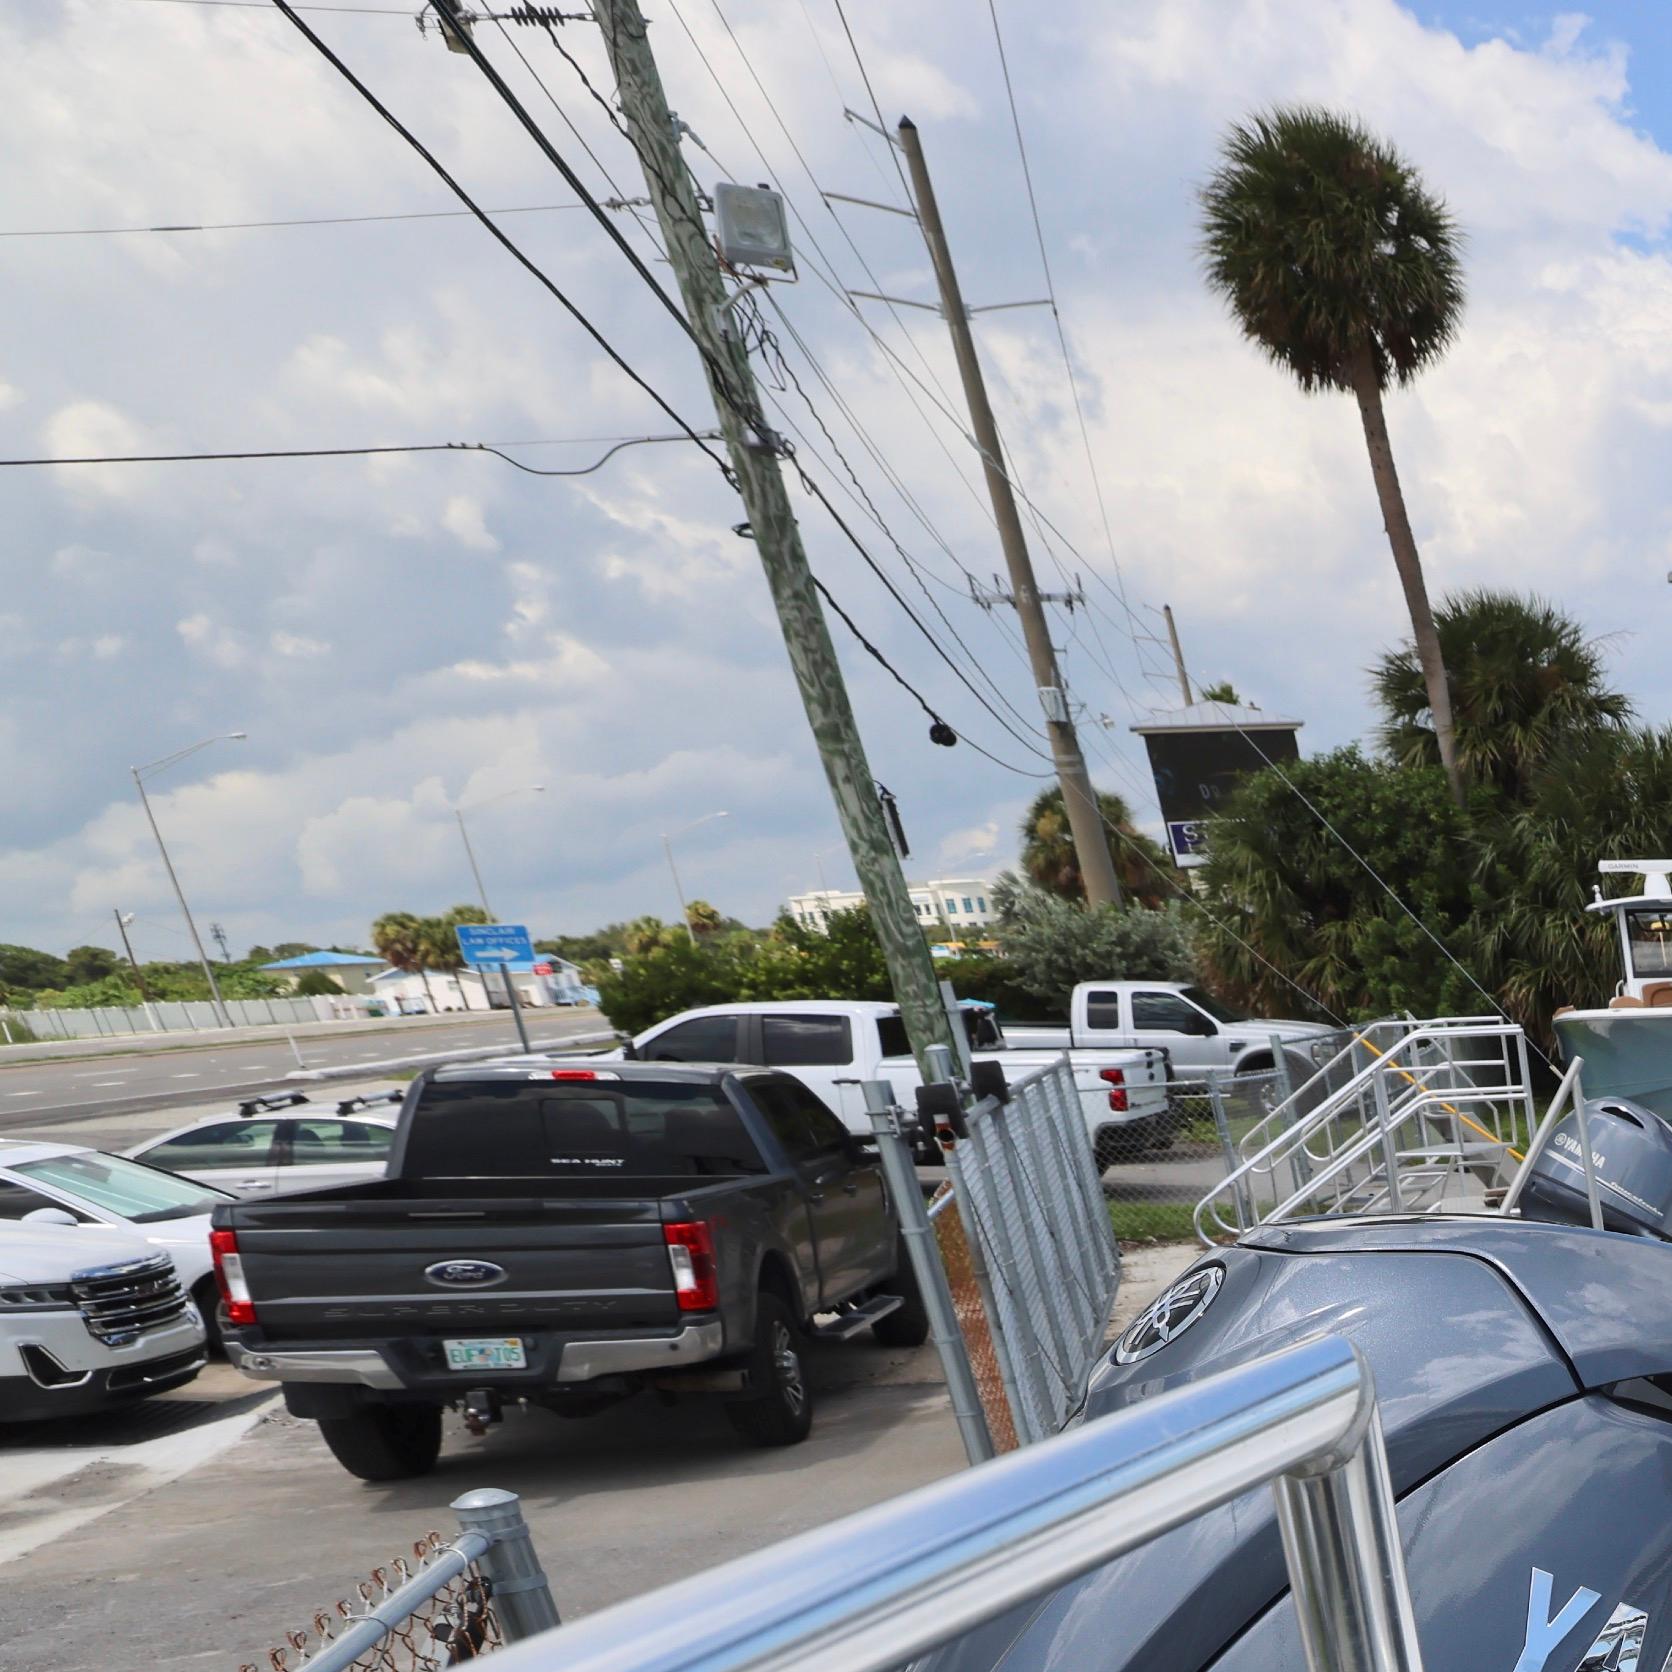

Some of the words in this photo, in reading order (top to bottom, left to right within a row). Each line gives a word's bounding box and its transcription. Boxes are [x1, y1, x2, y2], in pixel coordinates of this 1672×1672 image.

[1562, 1136, 1606, 1169] YAMHA
[443, 1263, 489, 1281] Ford
[324, 1303, 485, 1318] SUPER
[499, 1300, 618, 1312] DUTY
